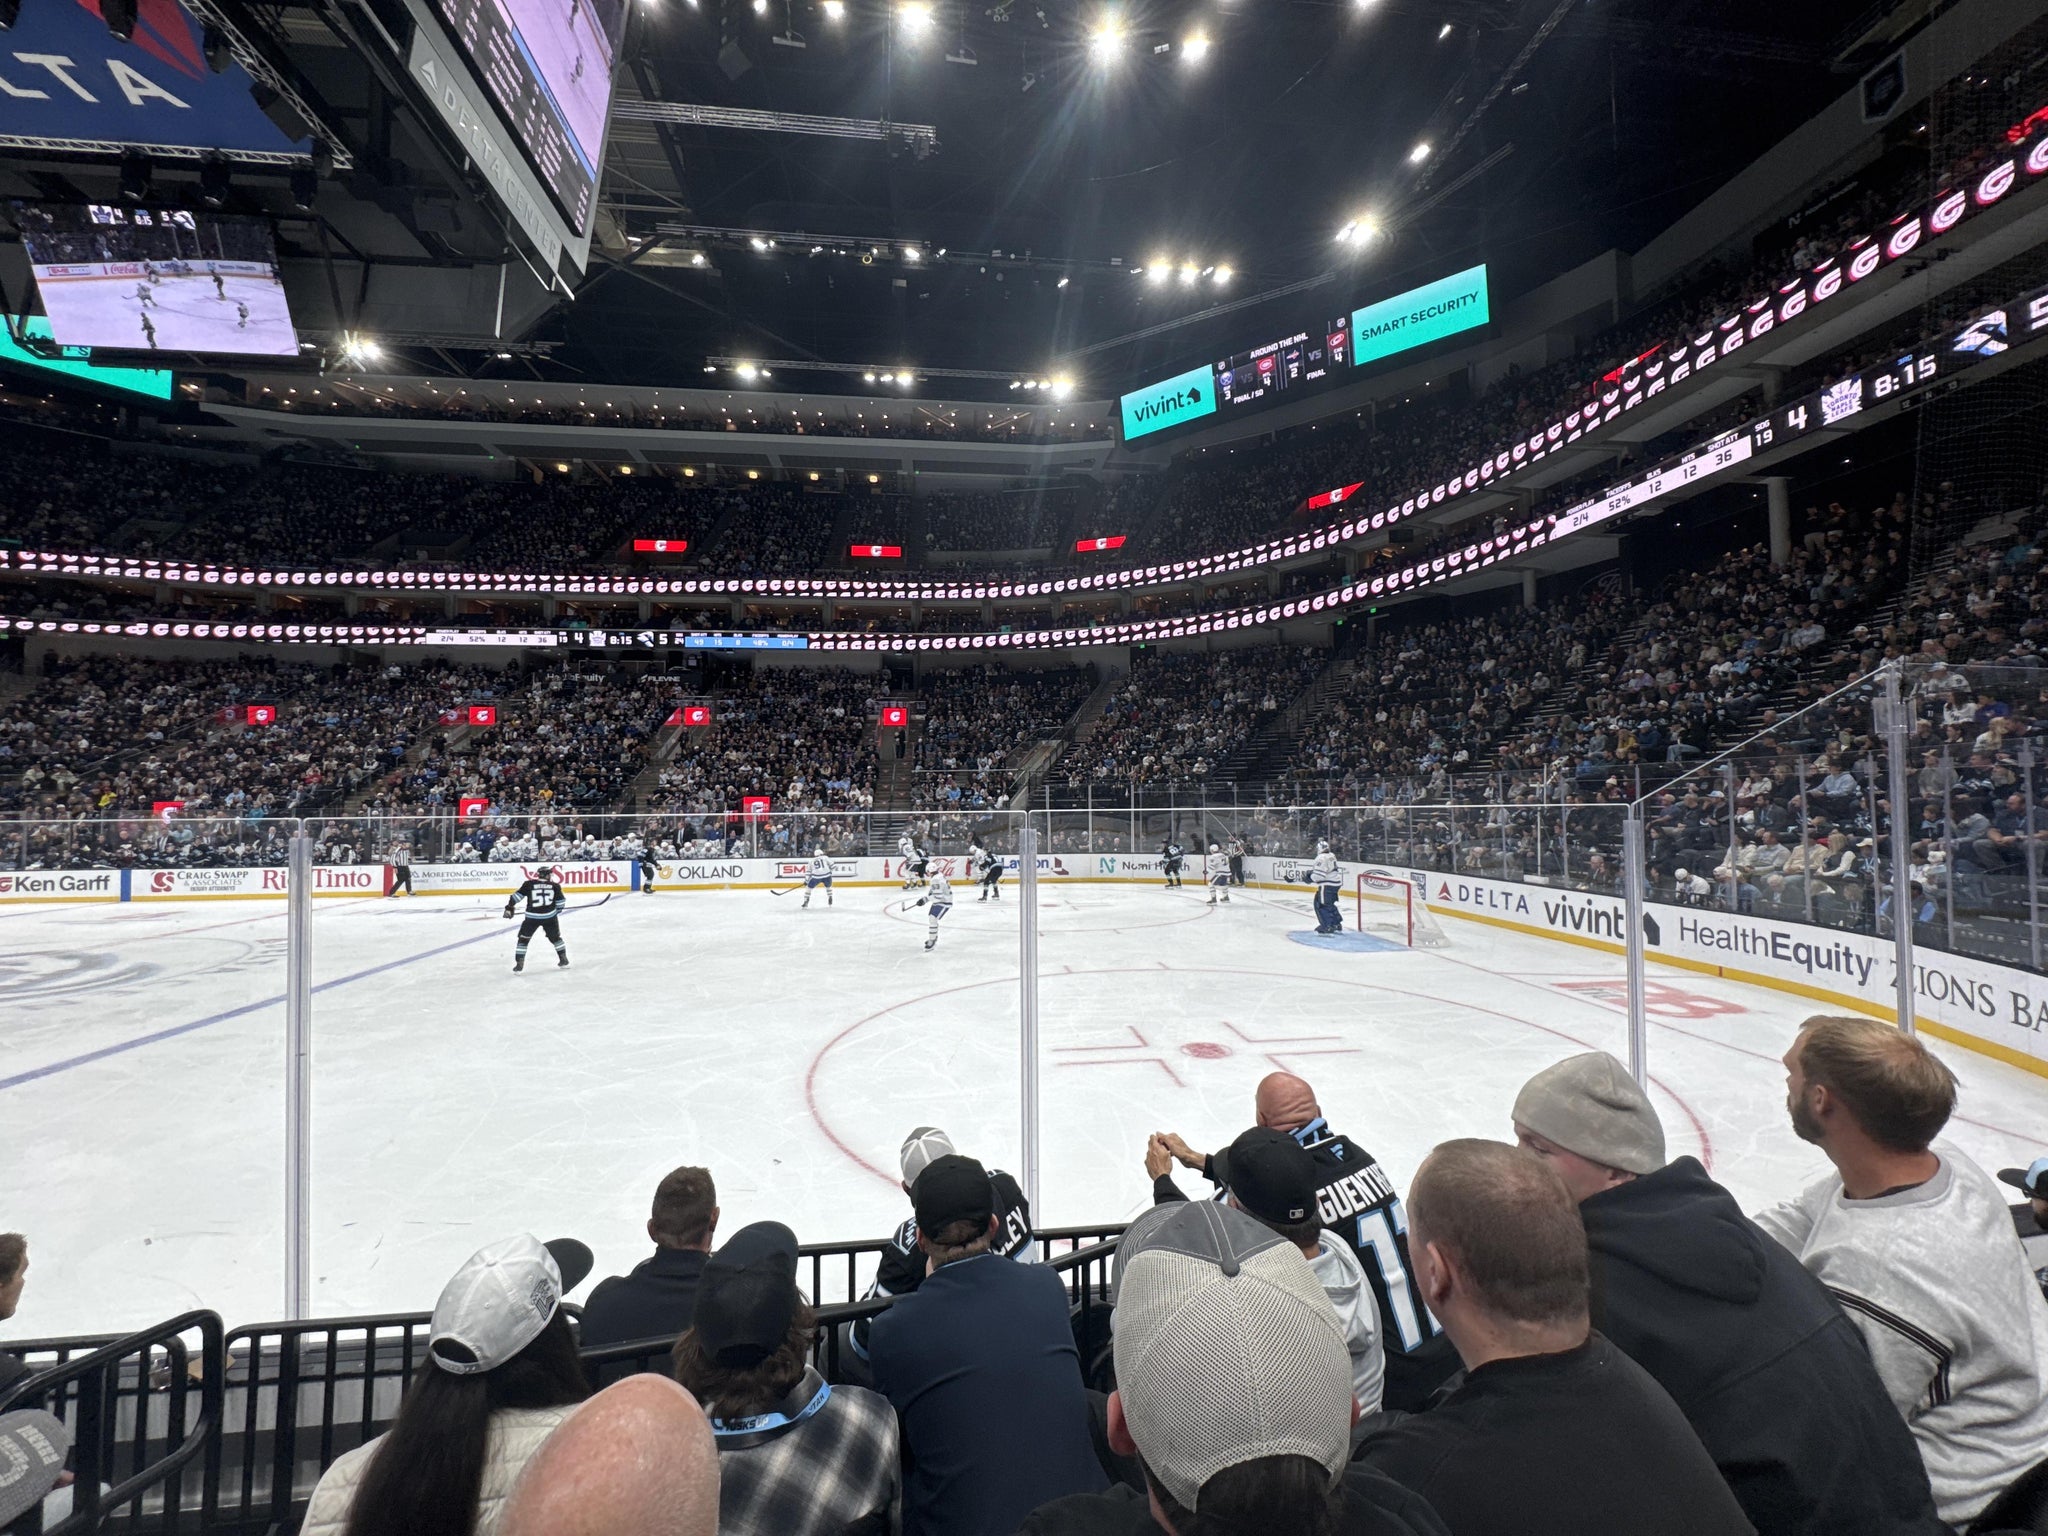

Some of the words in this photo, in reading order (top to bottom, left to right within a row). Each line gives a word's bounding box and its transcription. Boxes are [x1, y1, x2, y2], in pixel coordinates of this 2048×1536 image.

[444, 84, 502, 181] DELTA
[506, 178, 558, 260] CENTER
[1362, 316, 1407, 340] SMART
[1411, 291, 1478, 324] SECURITY
[1250, 343, 1278, 359] AROUND
[1279, 338, 1293, 350] THE
[1293, 332, 1308, 345] NHL
[1308, 349, 1322, 361] VS
[1334, 353, 1343, 362] 4
[1290, 368, 1298, 378] 2
[1306, 369, 1326, 380] FINAL
[1874, 354, 1937, 398] 8:15
[1263, 377, 1271, 386] 4
[1225, 390, 1231, 400] 3
[1233, 393, 1251, 404] FINAL
[1827, 393, 1858, 409] TORONTO
[1134, 392, 1184, 422] vivint
[1831, 399, 1853, 411] MAPLE
[1831, 405, 1853, 417] LEAFS
[1788, 405, 1808, 429] 4
[1755, 419, 1770, 432] SOG
[1755, 429, 1773, 446] 19
[1573, 512, 1589, 527] 2/4
[1609, 495, 1631, 511] 52%
[1649, 480, 1662, 494] 12
[1683, 465, 1697, 479] 12
[1716, 450, 1732, 466] 36
[574, 632, 584, 643] 4
[609, 636, 633, 645] 8:15
[659, 634, 668, 645] 5
[783, 865, 806, 873] SM
[814, 860, 825, 869] 91
[1003, 857, 1049, 872] Layon
[177, 871, 211, 880] CRAIG
[214, 870, 249, 879] SWAPP
[262, 870, 289, 890] Ri
[312, 868, 372, 888] Tinto
[551, 865, 618, 884] Smith's
[678, 866, 743, 879] OKLAND
[15, 877, 55, 892] Ken
[60, 875, 110, 891] Garff
[531, 889, 555, 907] 52
[1458, 884, 1530, 914] DELTA
[1544, 895, 1625, 939] vivint
[1679, 917, 1873, 986] HealthEquity
